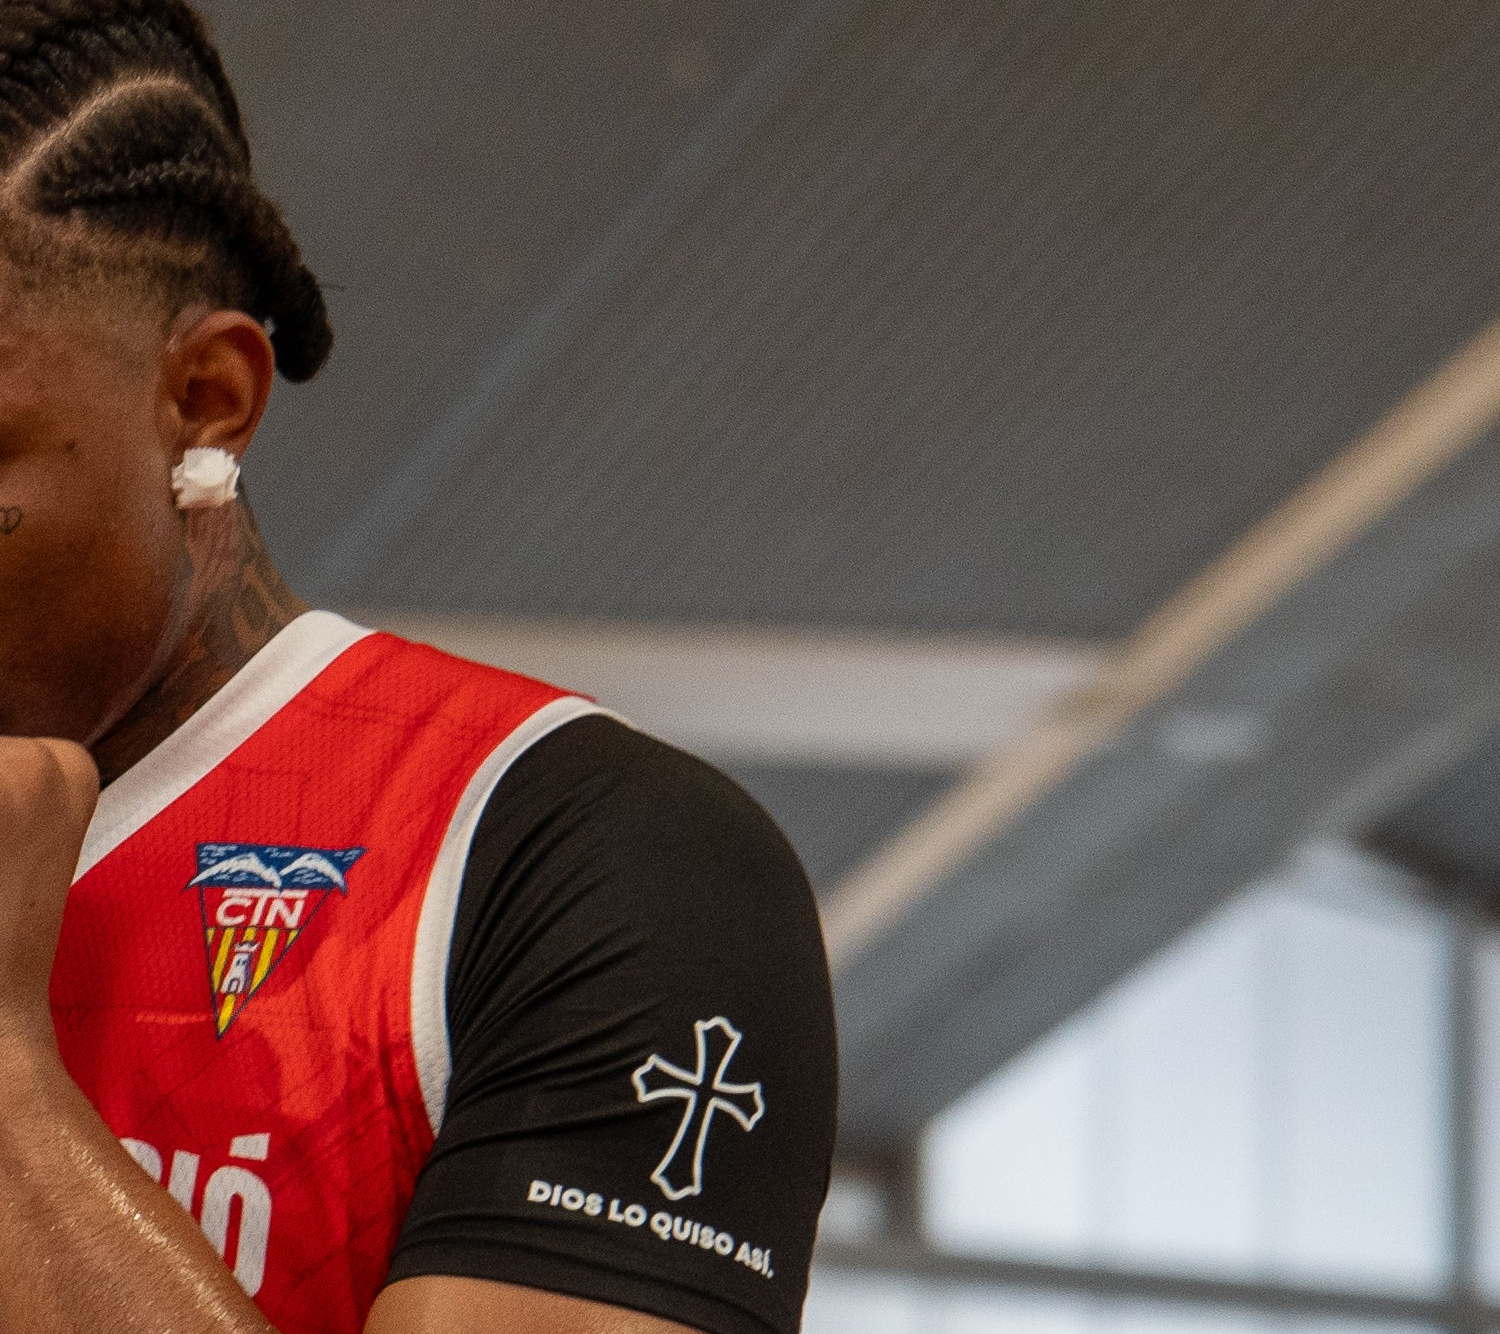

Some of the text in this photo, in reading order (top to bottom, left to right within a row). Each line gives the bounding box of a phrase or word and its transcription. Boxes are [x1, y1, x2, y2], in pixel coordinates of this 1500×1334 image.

[215, 888, 309, 929] CTN
[526, 1179, 604, 1217] DIOS
[607, 1197, 649, 1228] LO
[650, 1210, 735, 1257] QUISO
